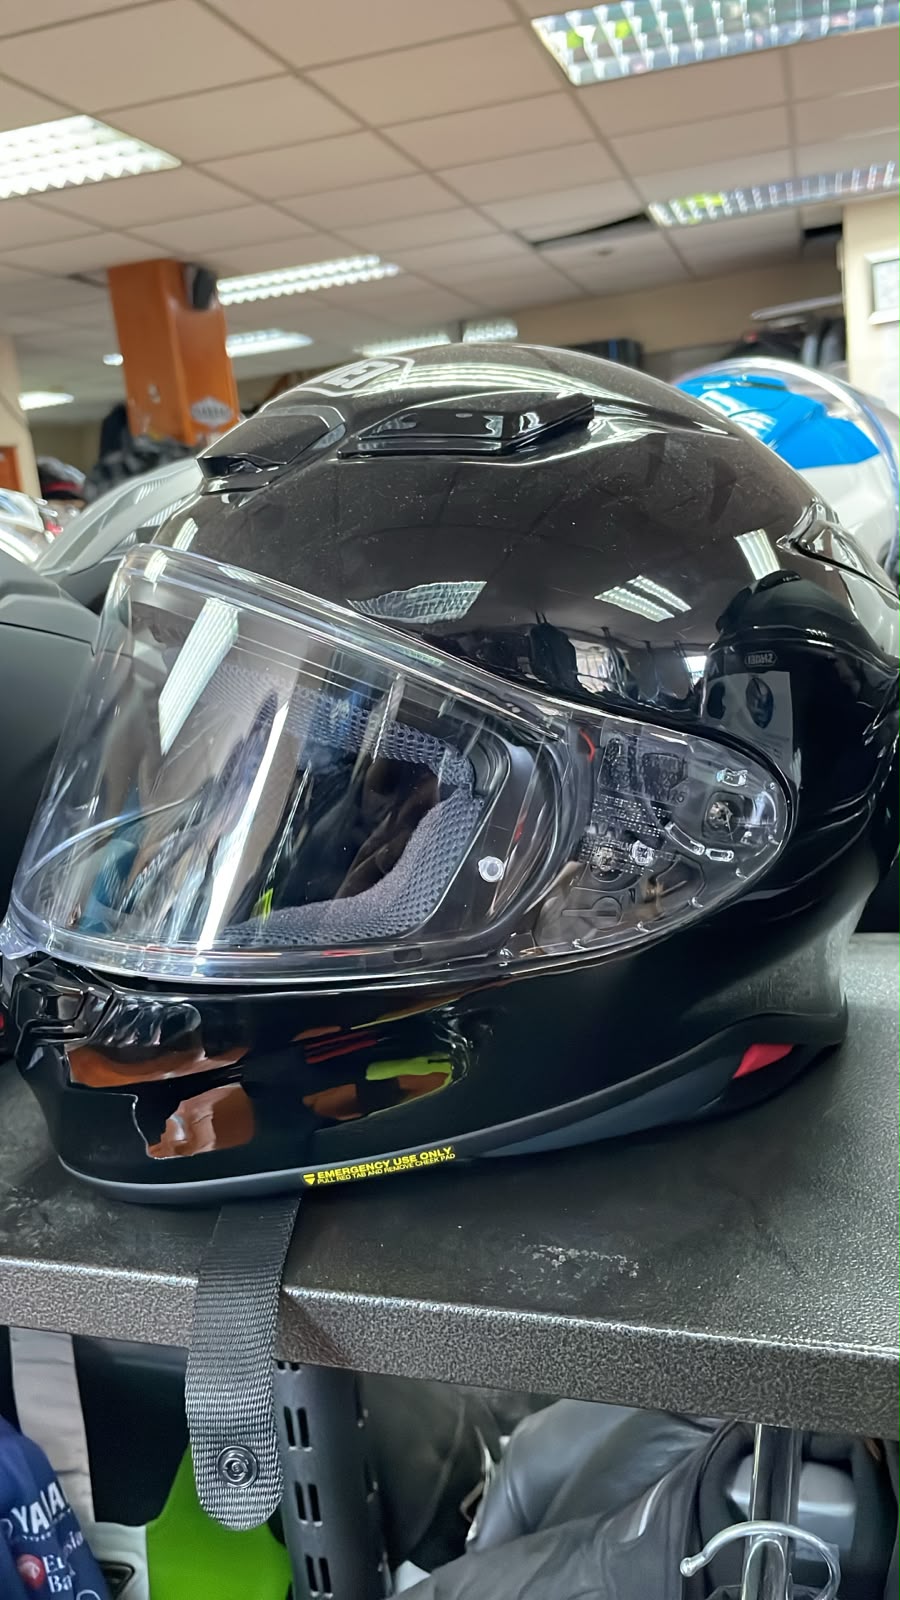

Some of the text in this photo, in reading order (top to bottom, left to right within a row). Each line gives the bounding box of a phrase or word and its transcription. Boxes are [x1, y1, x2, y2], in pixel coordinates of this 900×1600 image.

[317, 1147, 452, 1179] EMERGENCY USE ONLY
[317, 1177, 336, 1185] PULL
[352, 1171, 367, 1179] TAB
[368, 1168, 383, 1177] AND
[384, 1162, 415, 1174] REMOVE
[415, 1157, 440, 1167] CHEEK
[440, 1153, 456, 1163] PAD
